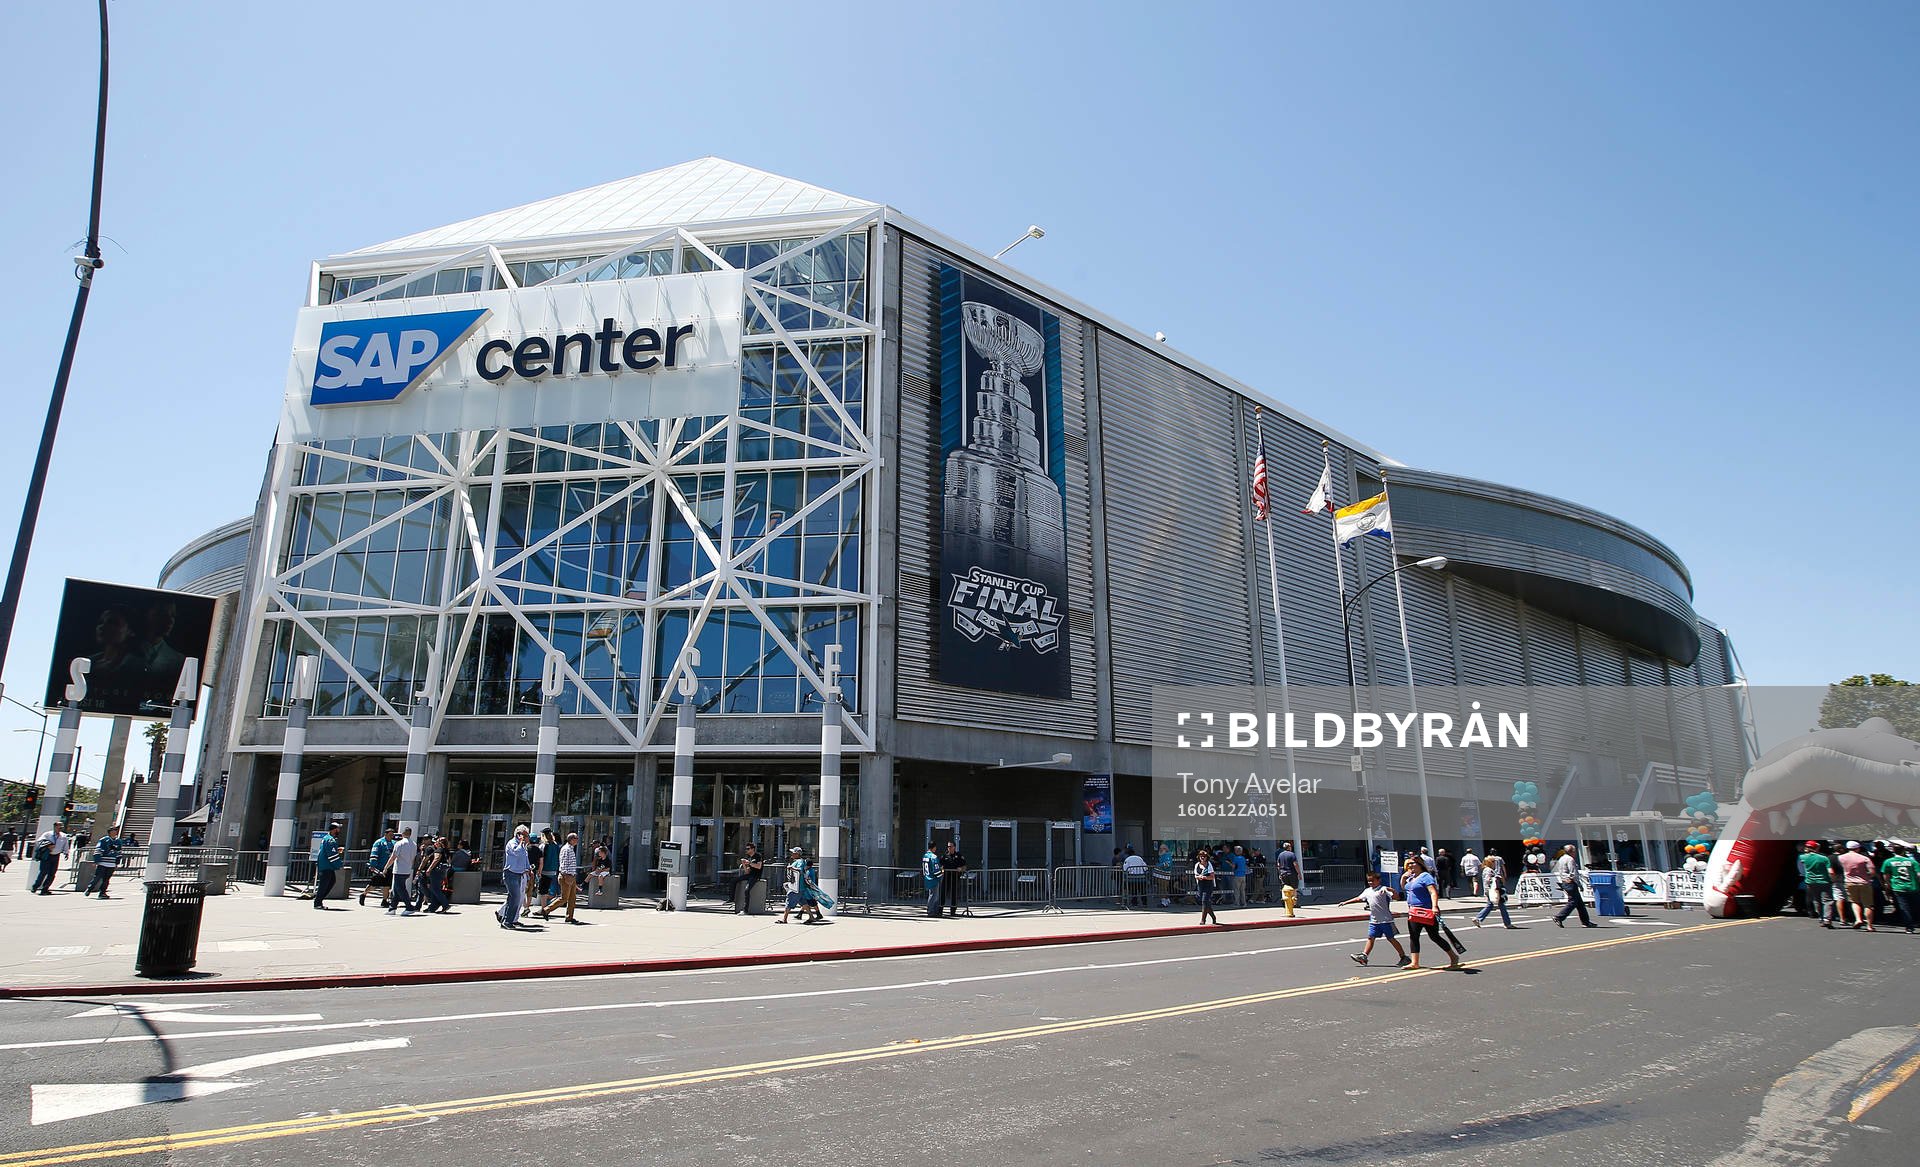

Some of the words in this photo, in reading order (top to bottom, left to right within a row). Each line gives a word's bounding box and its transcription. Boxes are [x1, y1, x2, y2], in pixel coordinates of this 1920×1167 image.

[315, 328, 439, 390] SAP
[475, 317, 693, 382] center
[971, 570, 1020, 591] STANLEY
[1021, 583, 1045, 597] CUP
[953, 581, 1059, 623] FINAL
[520, 727, 527, 738] 5
[1668, 874, 1697, 882] THIS
[1669, 882, 1704, 890] SHAR
[1669, 890, 1704, 898] TERRITO
